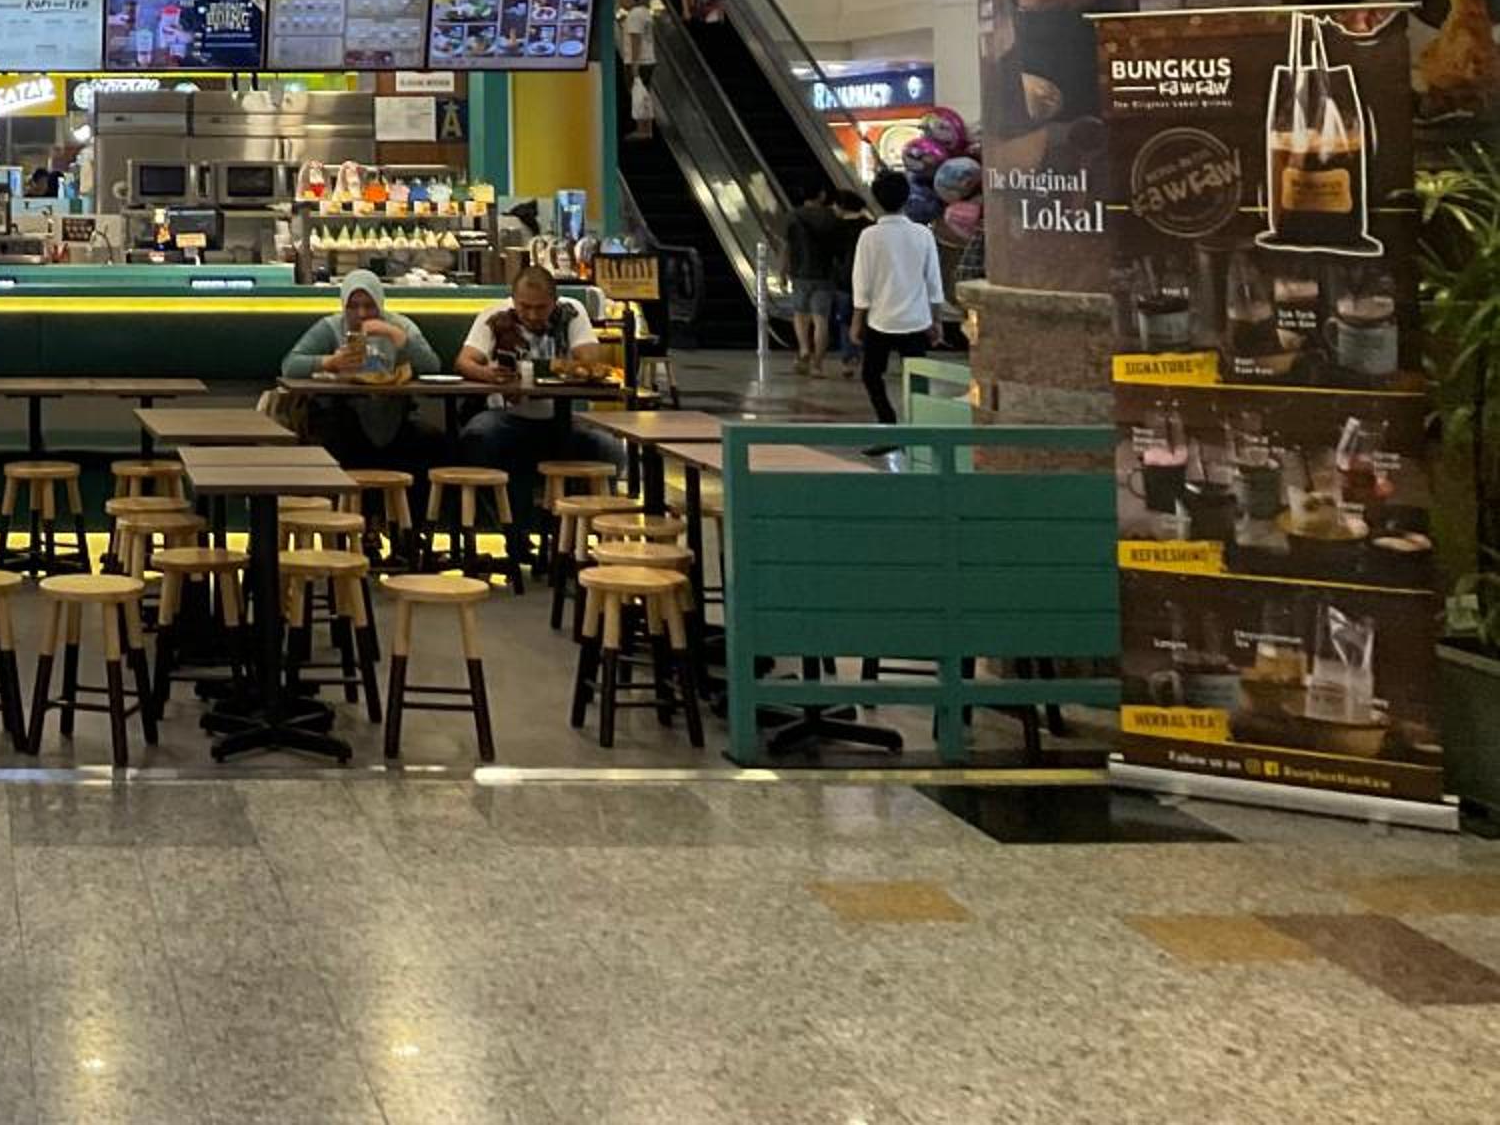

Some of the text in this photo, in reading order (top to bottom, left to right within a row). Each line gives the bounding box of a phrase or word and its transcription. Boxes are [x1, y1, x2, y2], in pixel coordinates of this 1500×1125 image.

[1111, 58, 1232, 80] BUNGKUS
[987, 166, 1088, 197] The Original
[1020, 199, 1105, 232] Lokal
